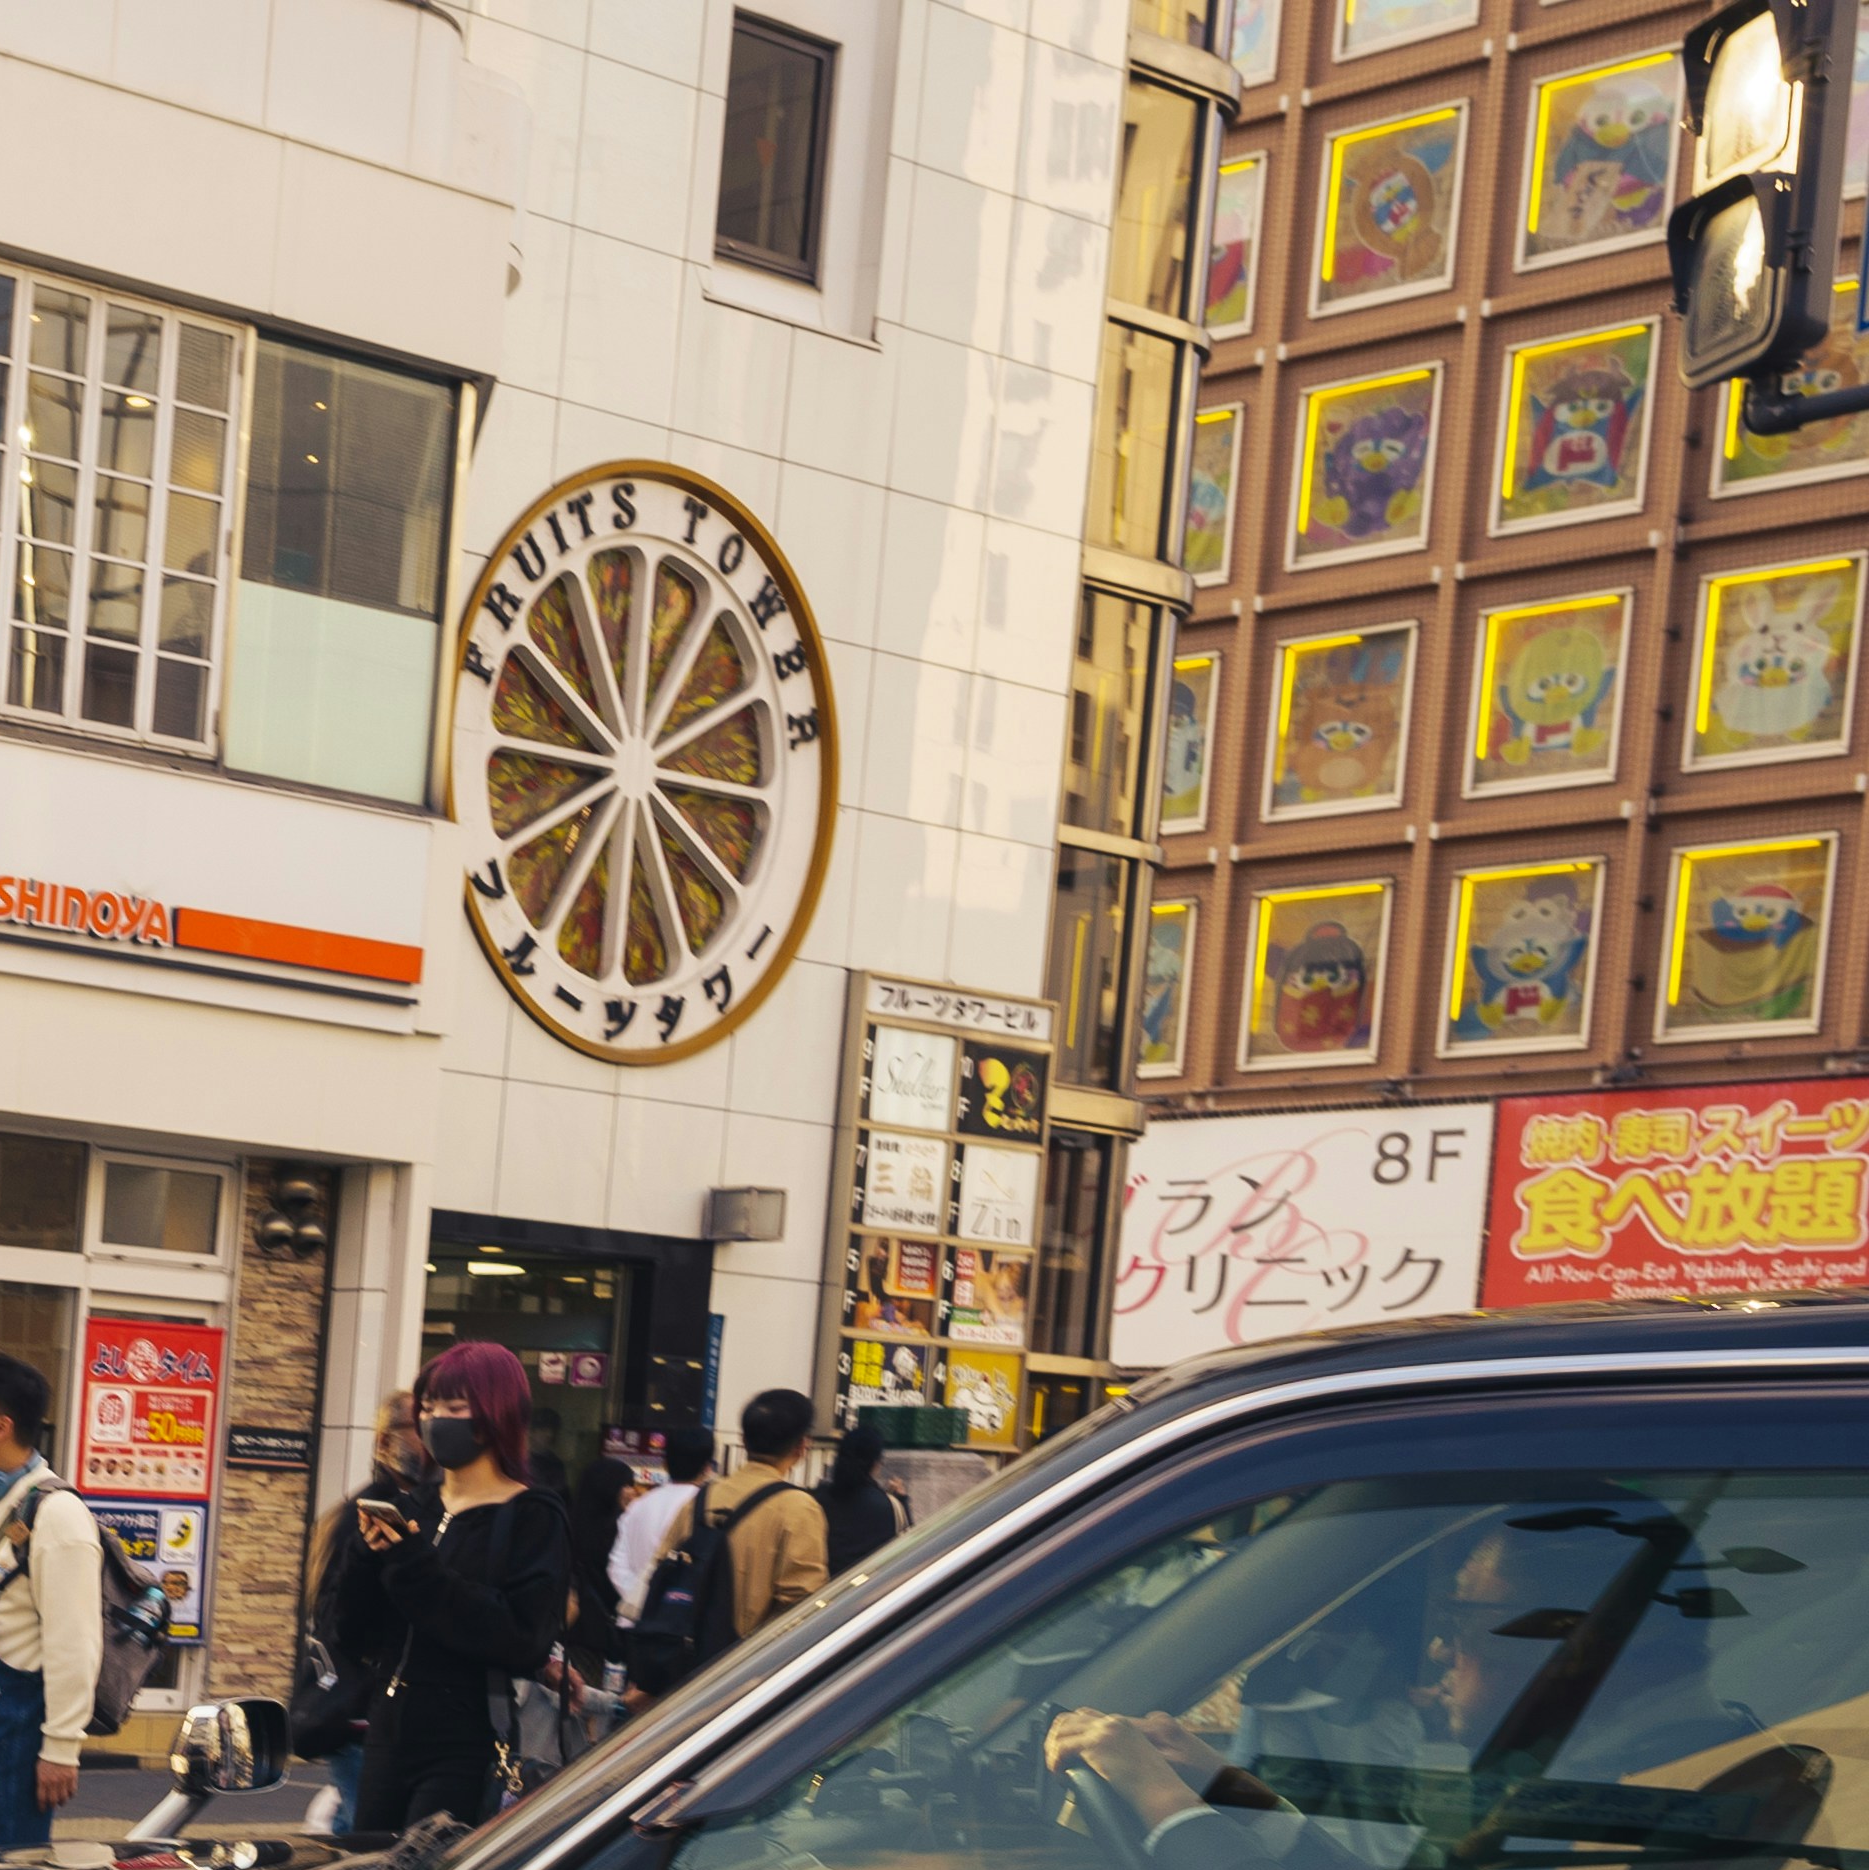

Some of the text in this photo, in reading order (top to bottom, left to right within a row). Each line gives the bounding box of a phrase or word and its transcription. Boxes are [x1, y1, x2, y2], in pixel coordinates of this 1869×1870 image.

[463, 482, 819, 750] FRUITS TOWER
[879, 985, 1041, 1032] フルーツタワービル
[1372, 1129, 1467, 1186] 8F
[1515, 1156, 1865, 1259] 食べ放題
[1113, 1247, 1444, 1315] クリニック
[1770, 1256, 1823, 1277] Sushi
[1825, 1256, 1867, 1276] and
